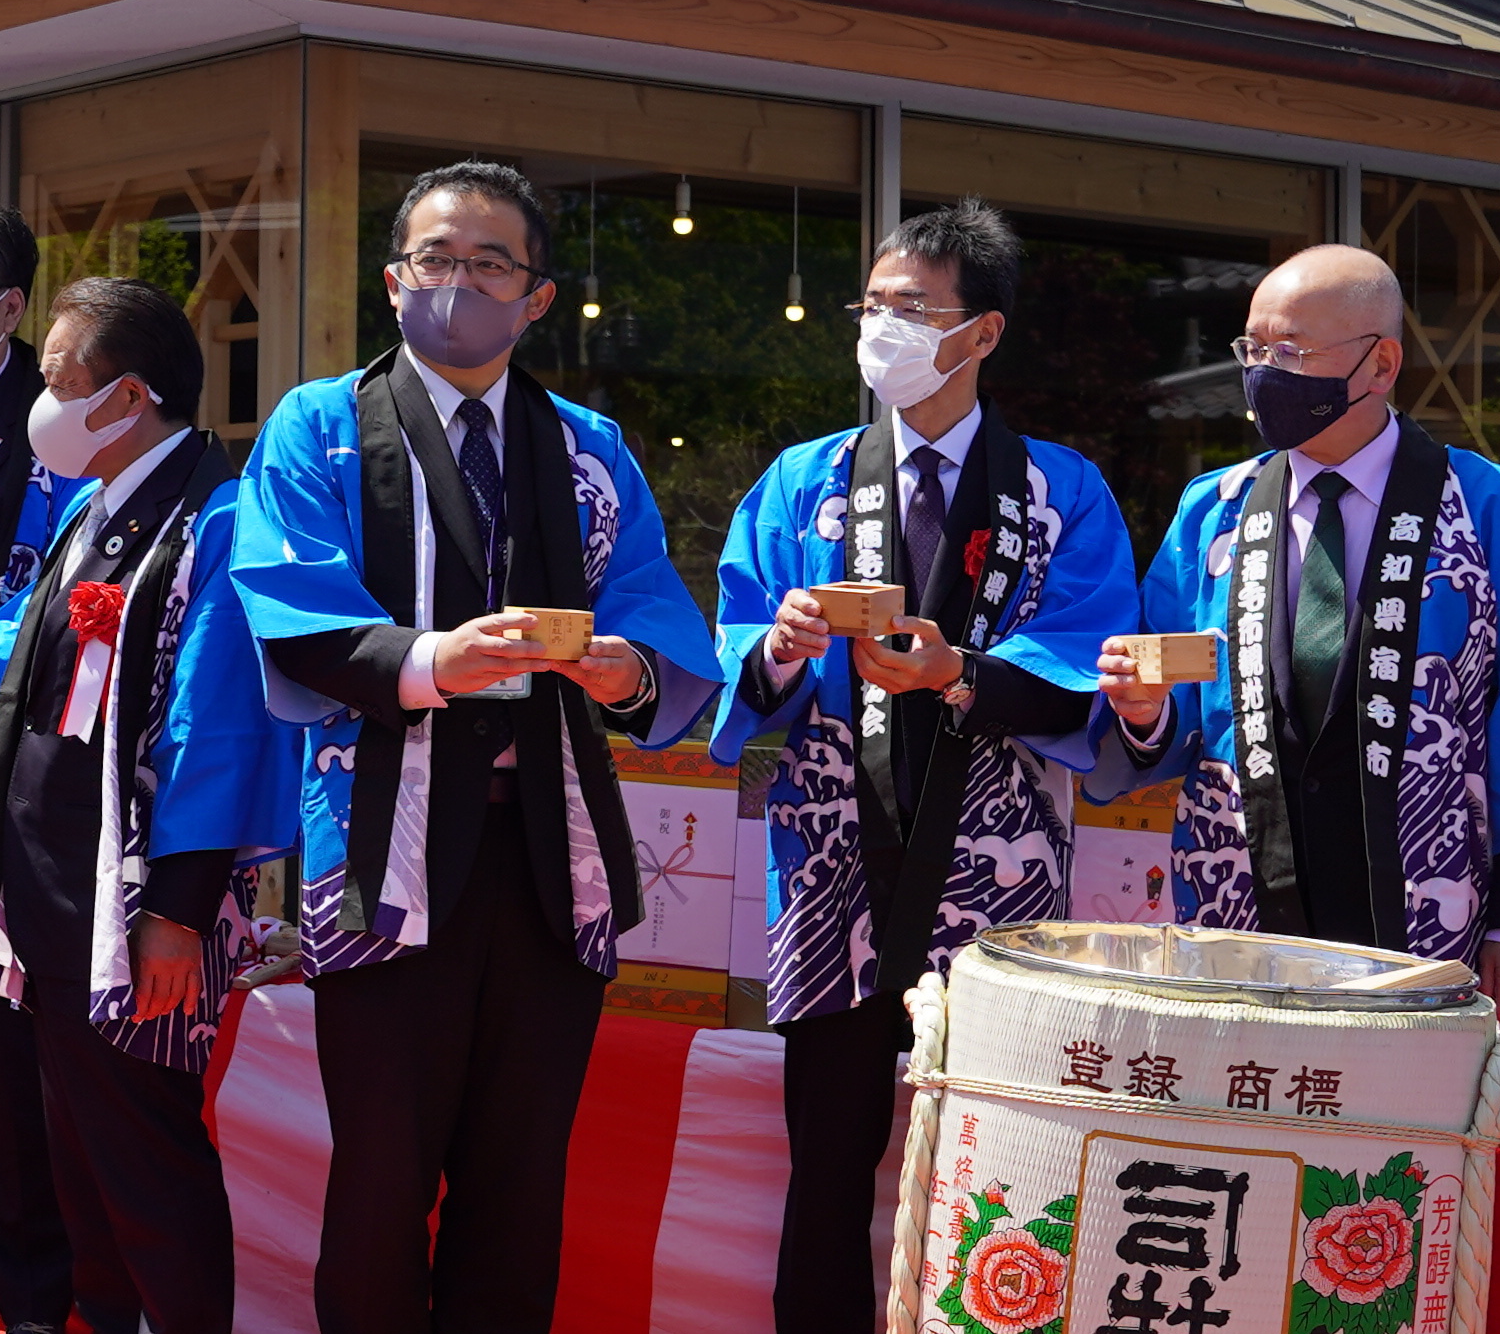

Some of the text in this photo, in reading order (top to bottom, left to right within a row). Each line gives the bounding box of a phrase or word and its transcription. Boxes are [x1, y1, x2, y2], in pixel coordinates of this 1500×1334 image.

[1365, 512, 1424, 778] 高知県宿毛市
